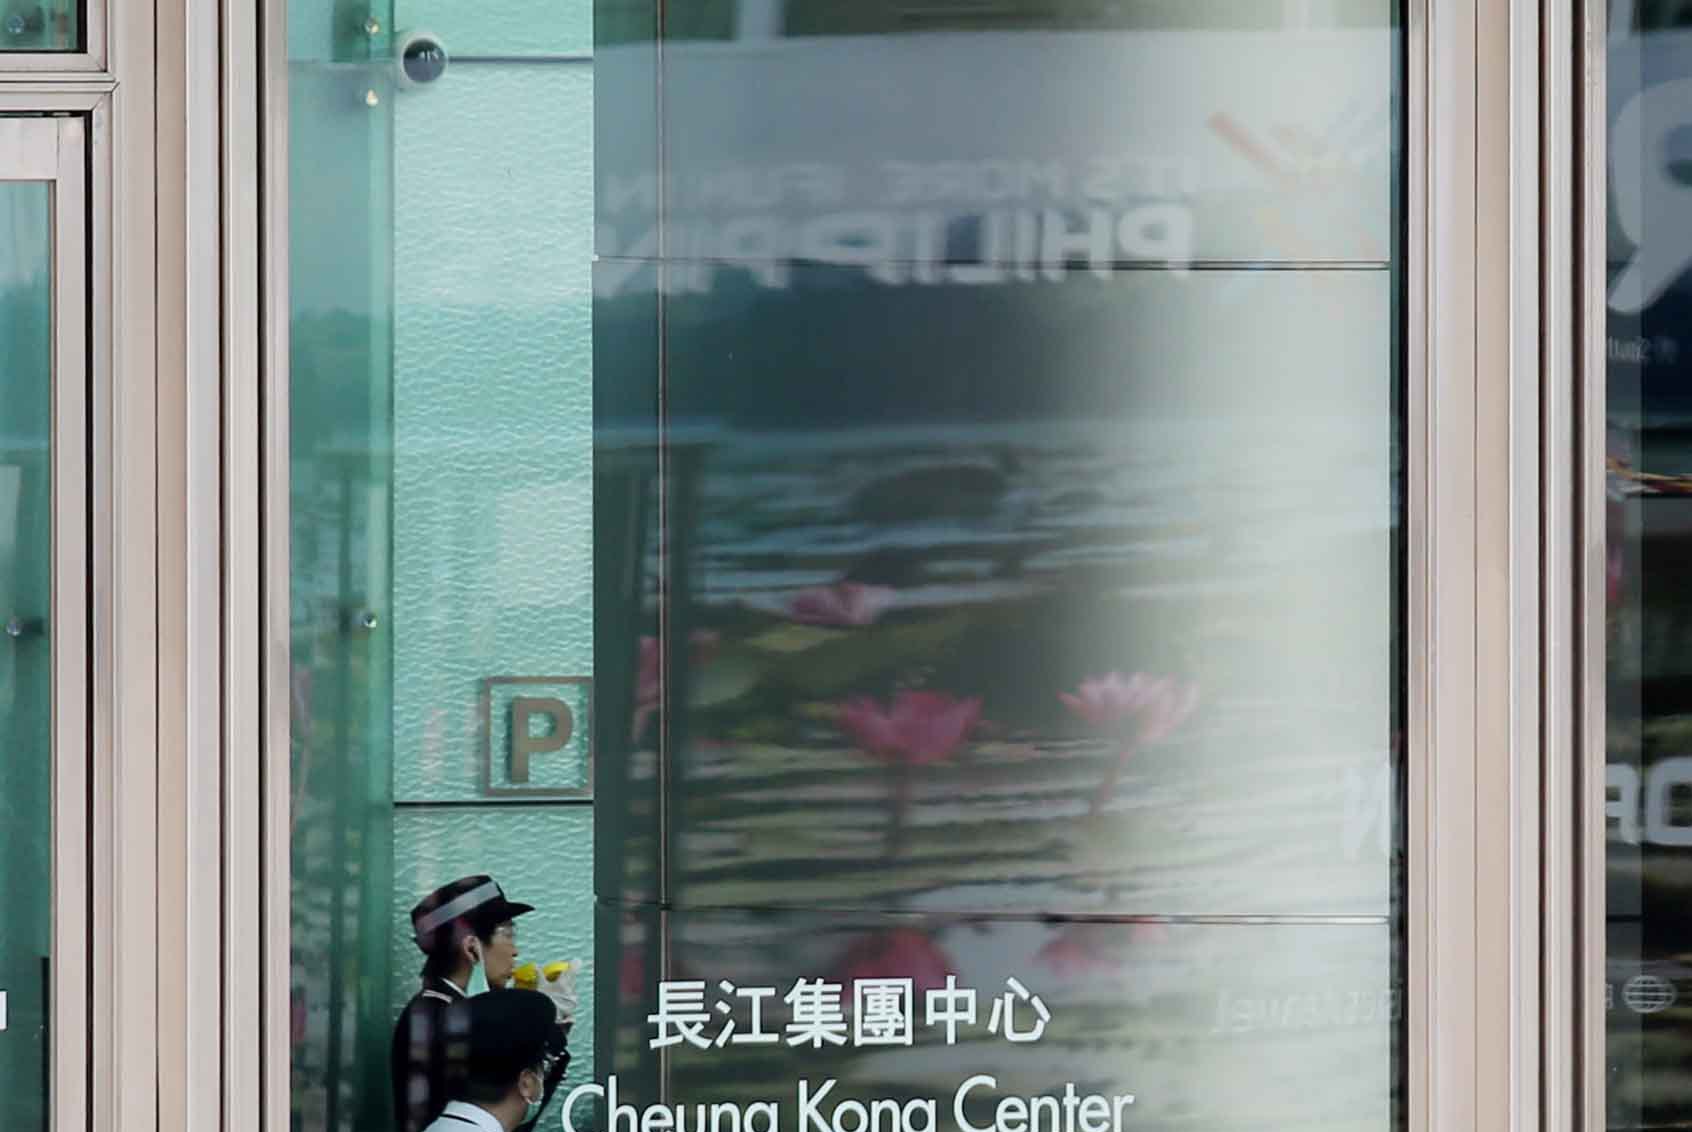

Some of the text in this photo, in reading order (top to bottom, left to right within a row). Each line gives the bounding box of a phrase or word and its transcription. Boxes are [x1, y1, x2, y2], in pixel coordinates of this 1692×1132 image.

[511, 697, 573, 784] P
[647, 975, 1052, 1049] 長江集團中心
